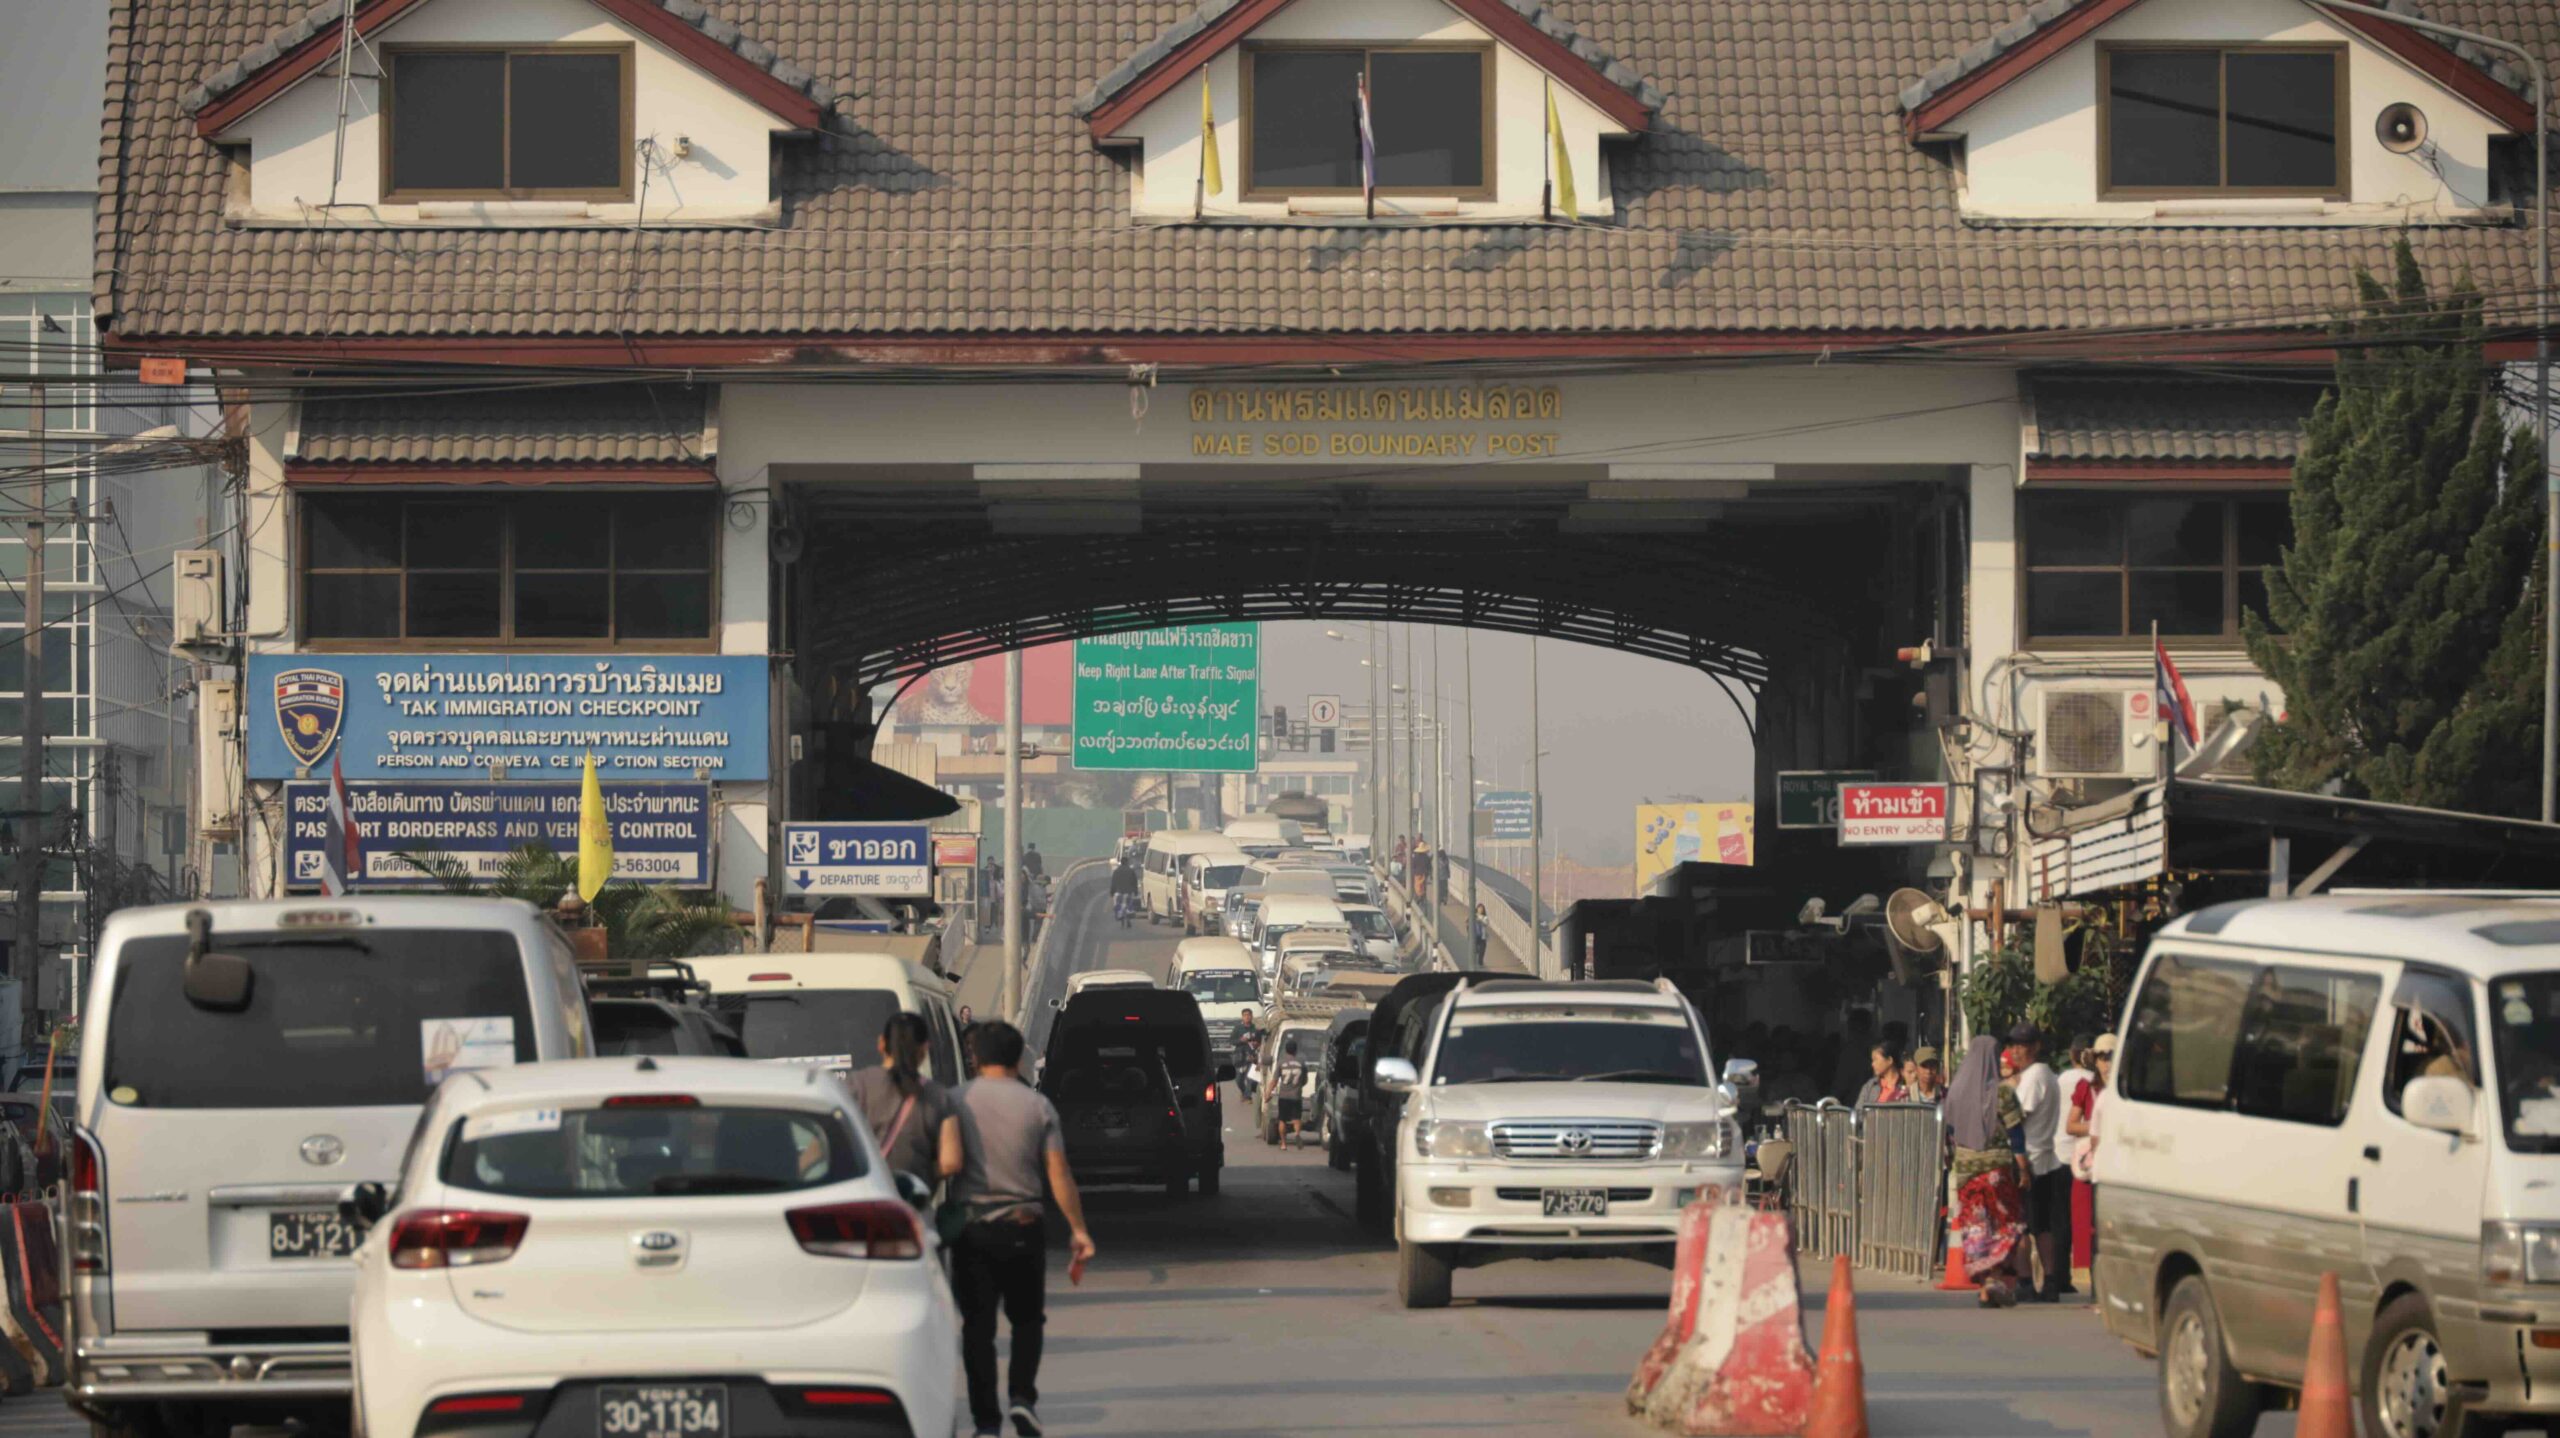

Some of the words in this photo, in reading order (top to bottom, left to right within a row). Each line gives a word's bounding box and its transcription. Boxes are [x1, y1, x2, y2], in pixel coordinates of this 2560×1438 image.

[1192, 433, 1252, 456] MAE
[1264, 433, 1321, 456] SOD
[1330, 433, 1476, 456] BOUNDARY
[1487, 433, 1561, 456] POST
[279, 674, 299, 685] ROYAL
[300, 673, 315, 681] THAI
[316, 674, 339, 686] POLICE
[375, 661, 723, 705] จุดผ่านแดนถาวรบ้านริมเมย
[1078, 663, 1102, 682] Keep
[1105, 664, 1131, 682] Right
[1134, 665, 1158, 679] Lane
[1160, 665, 1186, 680] After
[1189, 664, 1223, 680] Traffic
[1226, 666, 1256, 684] Signal
[400, 700, 438, 716] TAK
[445, 700, 572, 716] IMMIGRATION
[579, 699, 701, 716] CHECKPOINT
[387, 725, 729, 752] จุดตรวจบุคคลและยานพาหนะผ่านแดน
[377, 755, 434, 768] PERSON
[440, 755, 468, 768] AND
[663, 755, 724, 769] SECTION
[1853, 789, 1937, 816] ห้ามเข้า
[294, 820, 381, 839] PASORT
[387, 820, 498, 839] BORDERPASS
[504, 820, 539, 839] AND
[619, 821, 697, 839] CONTROL
[1843, 826, 1860, 836] NO
[1863, 825, 1900, 836] ENTRY
[827, 838, 917, 861] ขาออก
[820, 873, 881, 886] DEPARTURE
[1281, 1068, 1302, 1085] 77
[1545, 1195, 1604, 1212] 7J-5779
[604, 1398, 720, 1434] 30-1134
